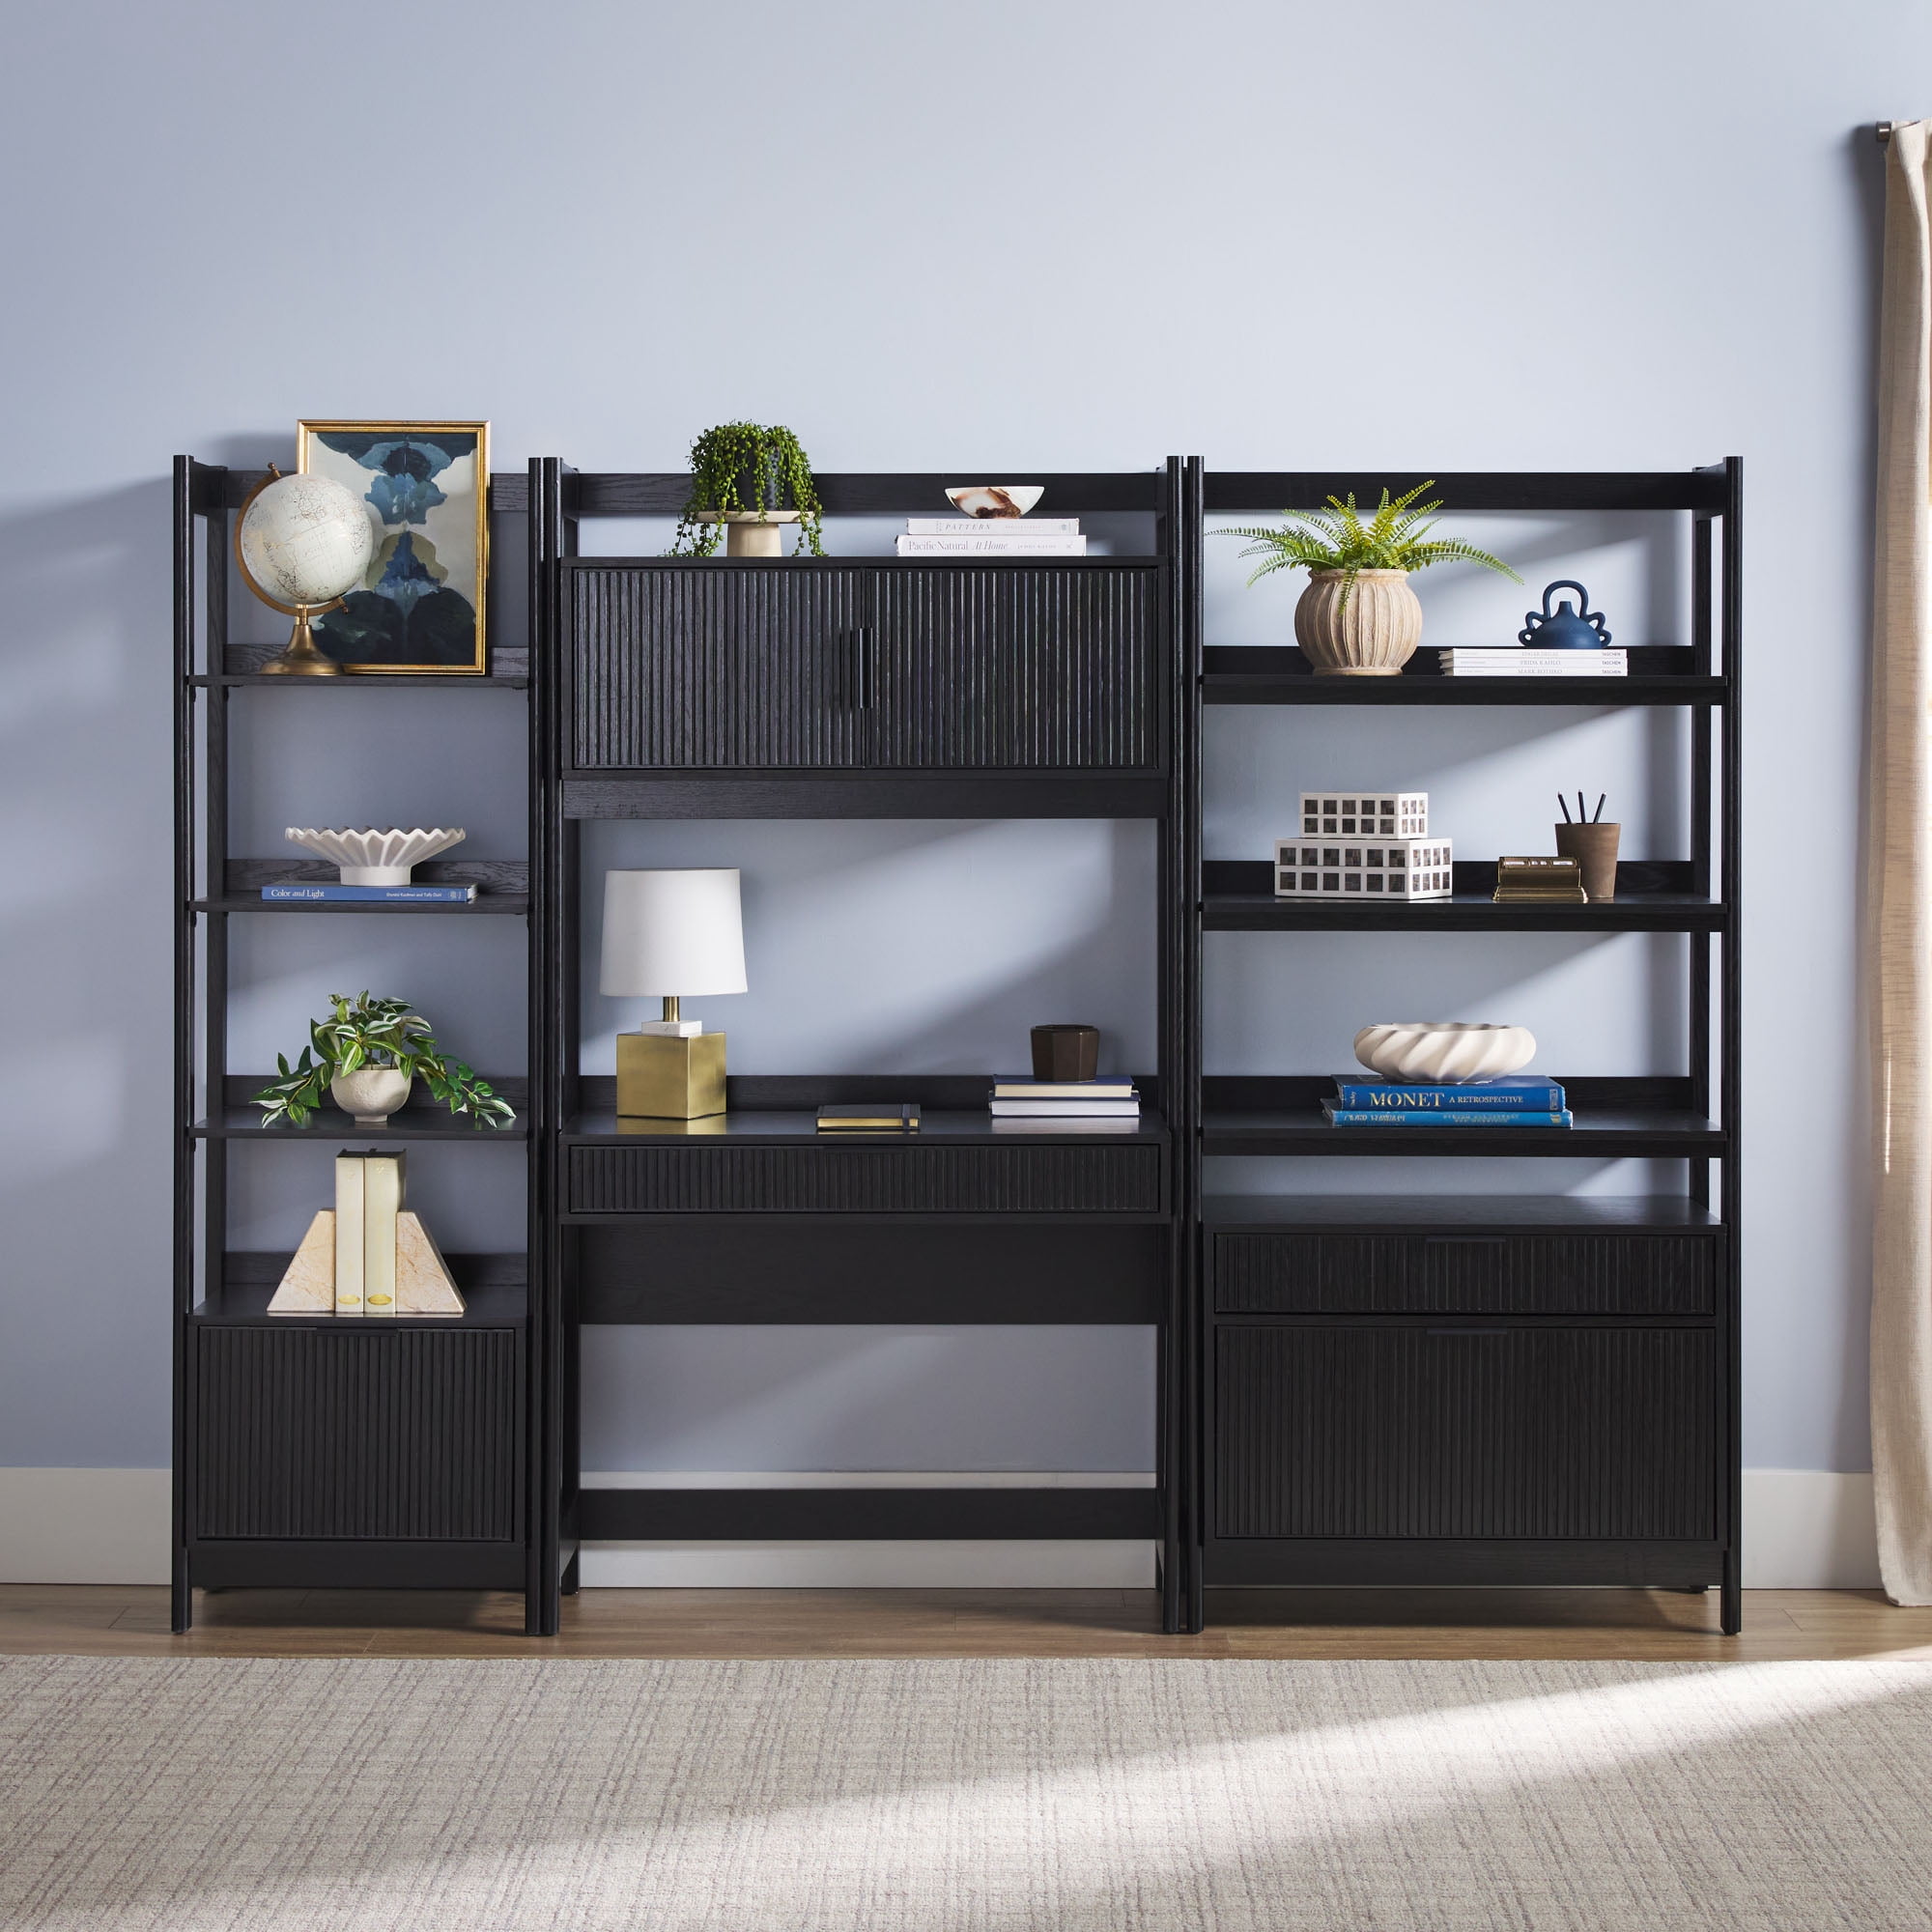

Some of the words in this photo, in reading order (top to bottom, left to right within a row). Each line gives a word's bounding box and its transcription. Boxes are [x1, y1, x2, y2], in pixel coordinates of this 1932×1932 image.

[908, 540, 936, 551] Pacific
[937, 540, 968, 551] Natural
[983, 540, 1009, 551] Home
[270, 889, 291, 897] Color
[292, 889, 305, 897] and
[306, 889, 325, 899] Light
[1369, 1093, 1445, 1107] MONET
